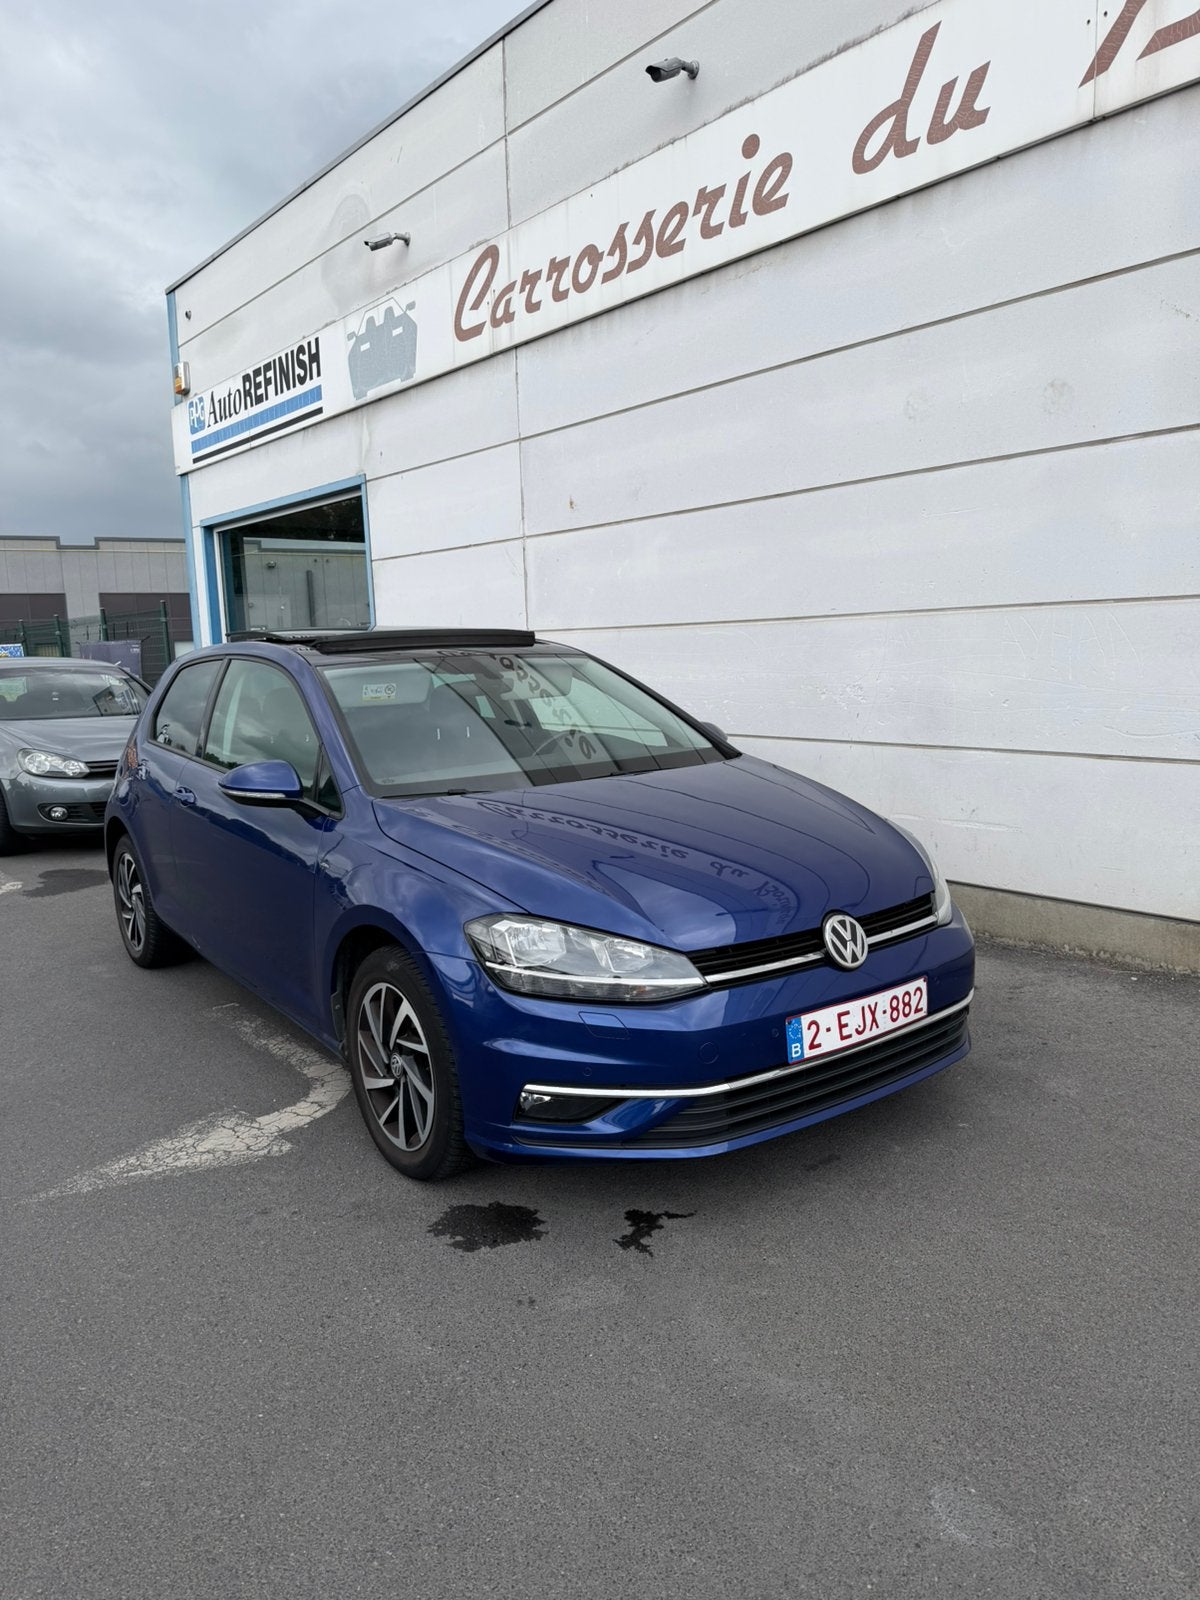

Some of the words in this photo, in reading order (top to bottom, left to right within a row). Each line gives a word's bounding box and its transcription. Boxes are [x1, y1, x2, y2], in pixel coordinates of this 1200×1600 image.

[453, 133, 793, 343] Carrosserie
[851, 21, 990, 175] du
[825, 914, 868, 969] VW
[791, 1042, 802, 1058] B
